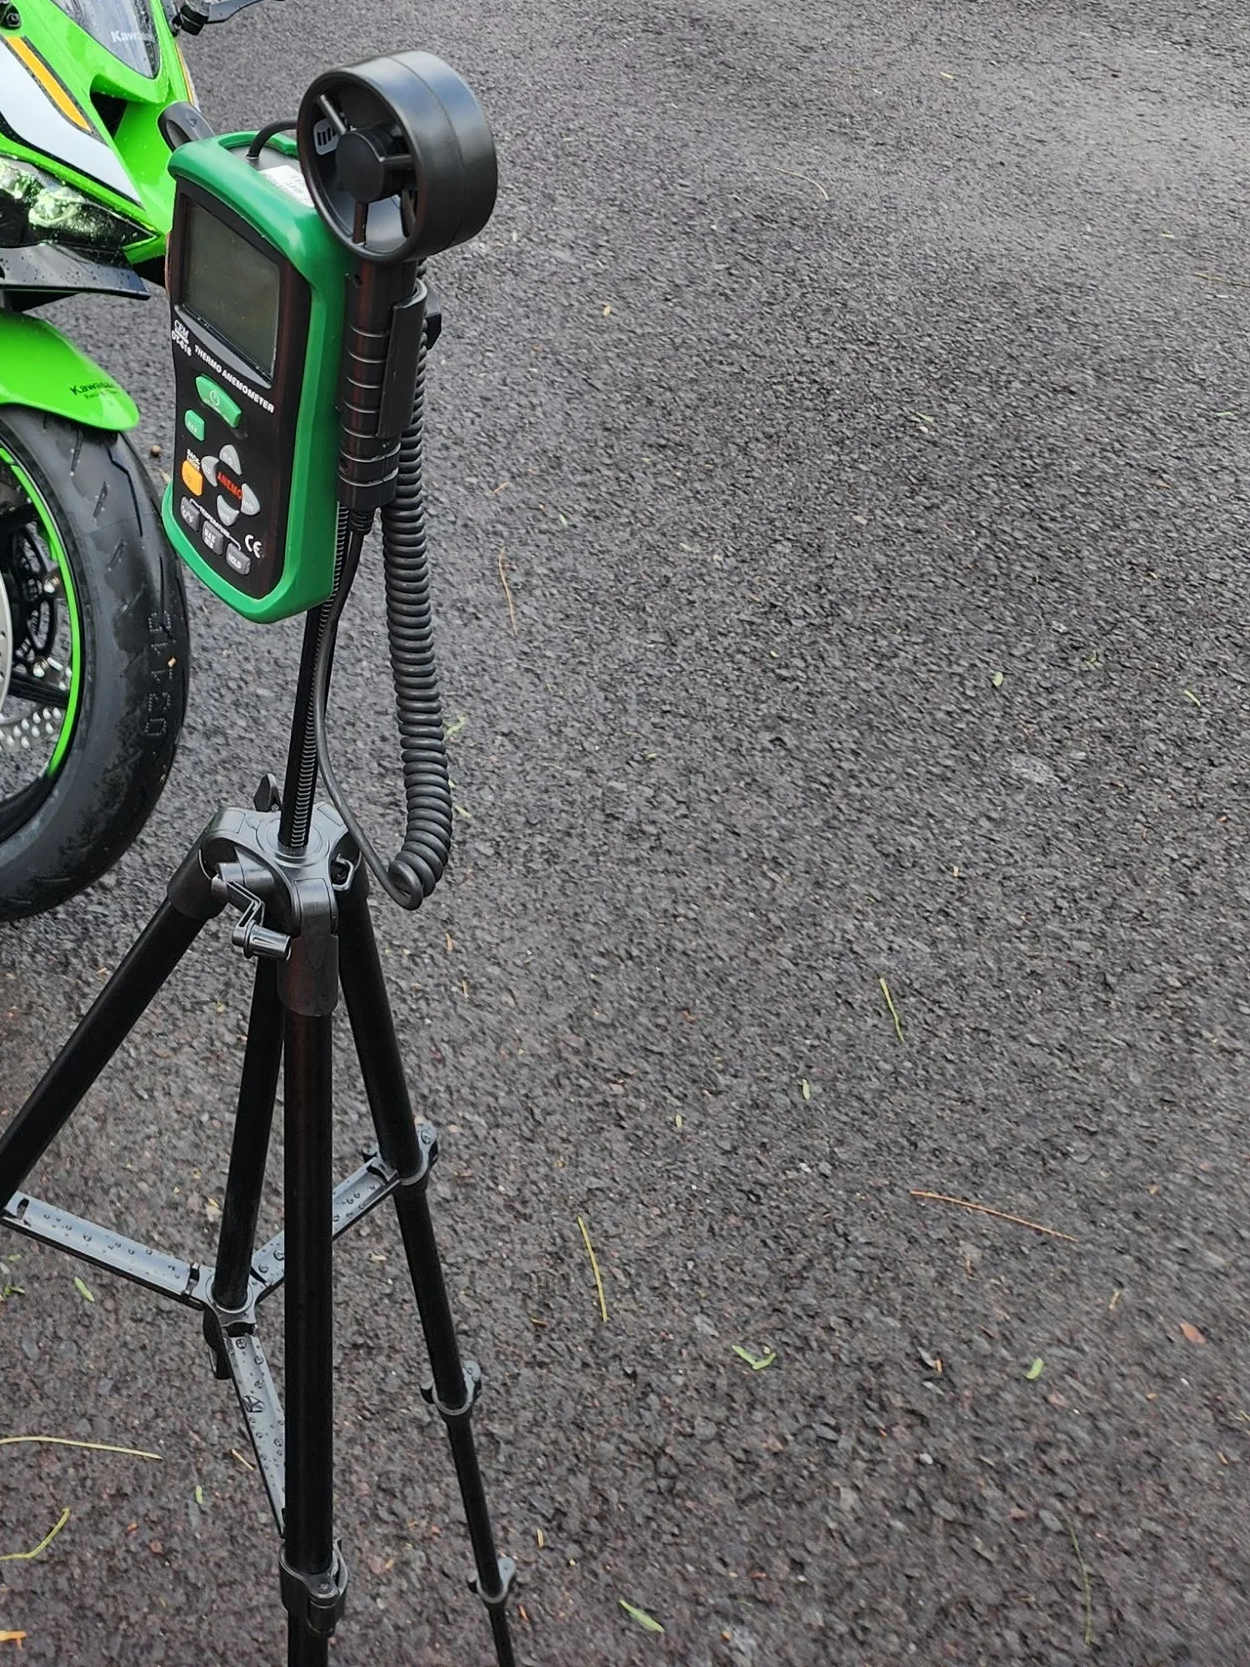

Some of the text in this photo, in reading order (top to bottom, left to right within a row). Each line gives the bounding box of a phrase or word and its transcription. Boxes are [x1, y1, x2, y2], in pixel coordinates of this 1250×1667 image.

[194, 344, 223, 374] THERMO
[221, 369, 275, 414] ANEMOMETER
[217, 472, 242, 500] ANEMO
